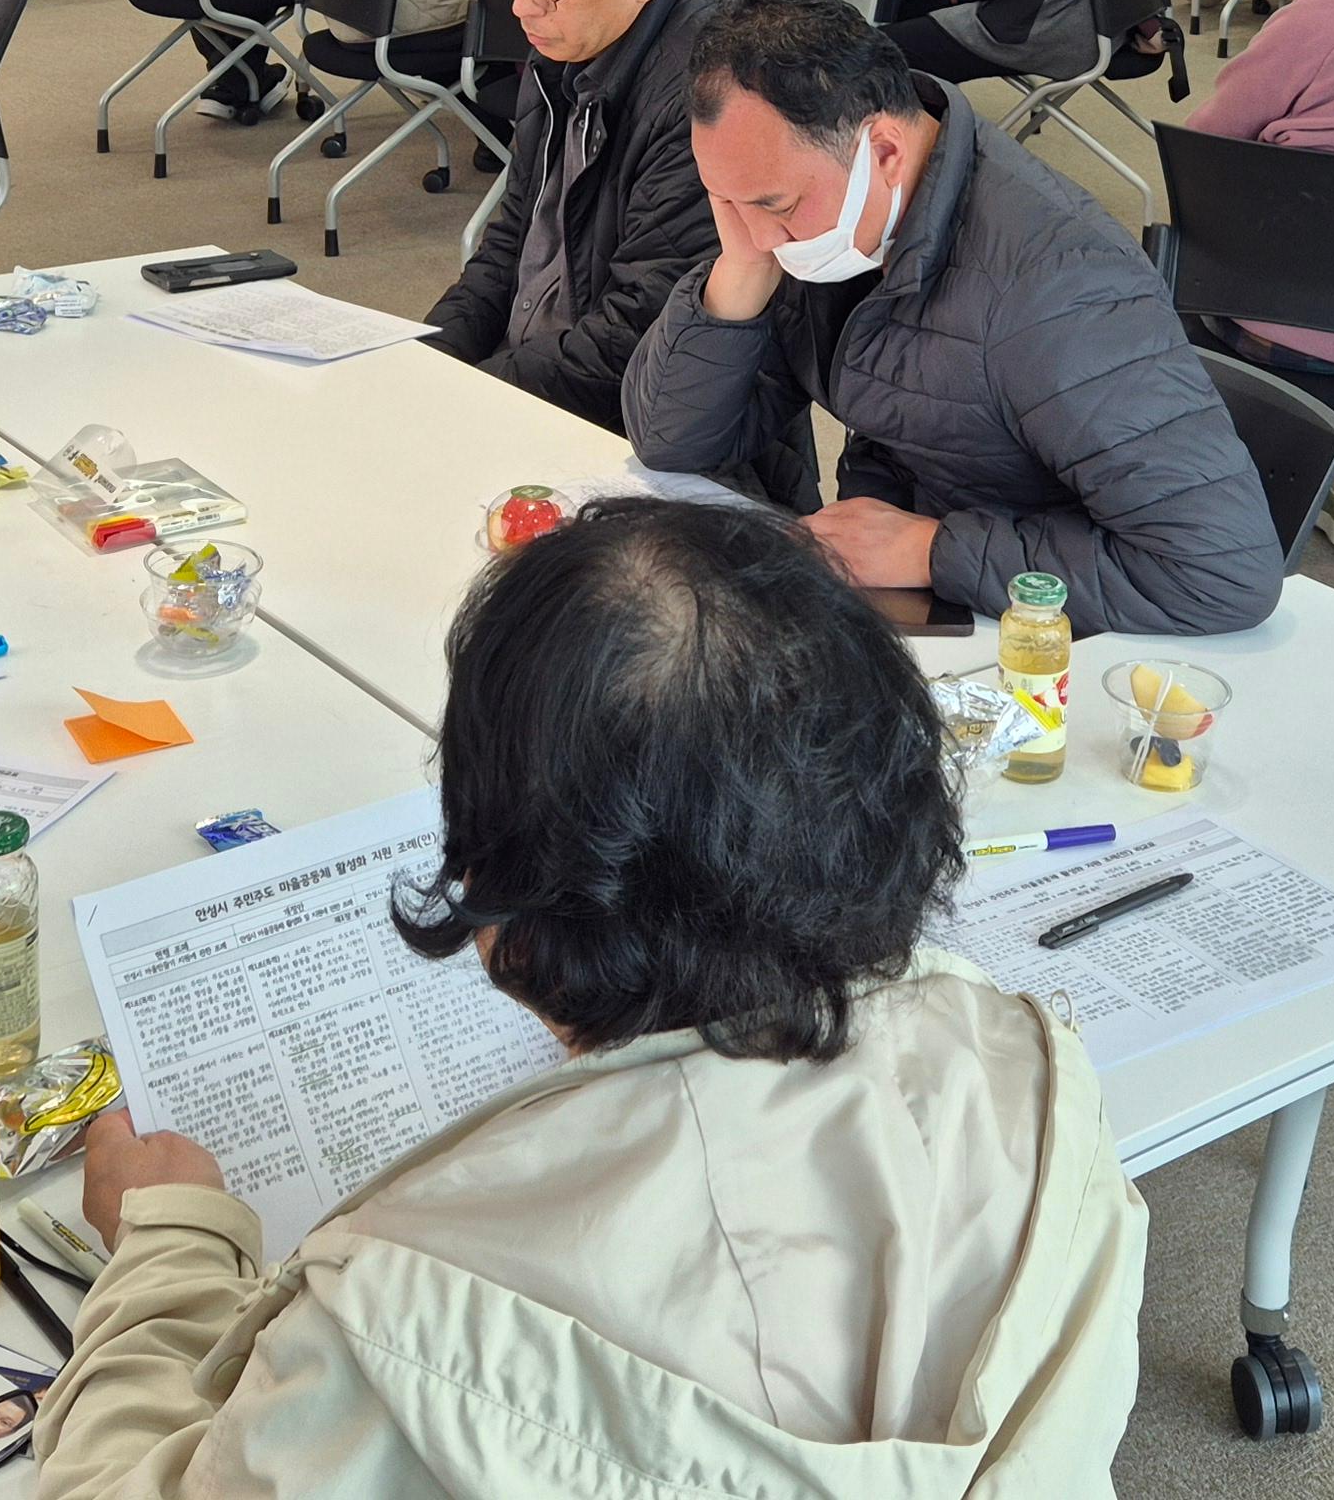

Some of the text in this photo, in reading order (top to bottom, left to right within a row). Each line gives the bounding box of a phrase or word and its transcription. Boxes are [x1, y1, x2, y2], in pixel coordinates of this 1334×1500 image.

[195, 831, 438, 923] 안성시 주민주도 마을공동체 활성화 지원 조례(안)
